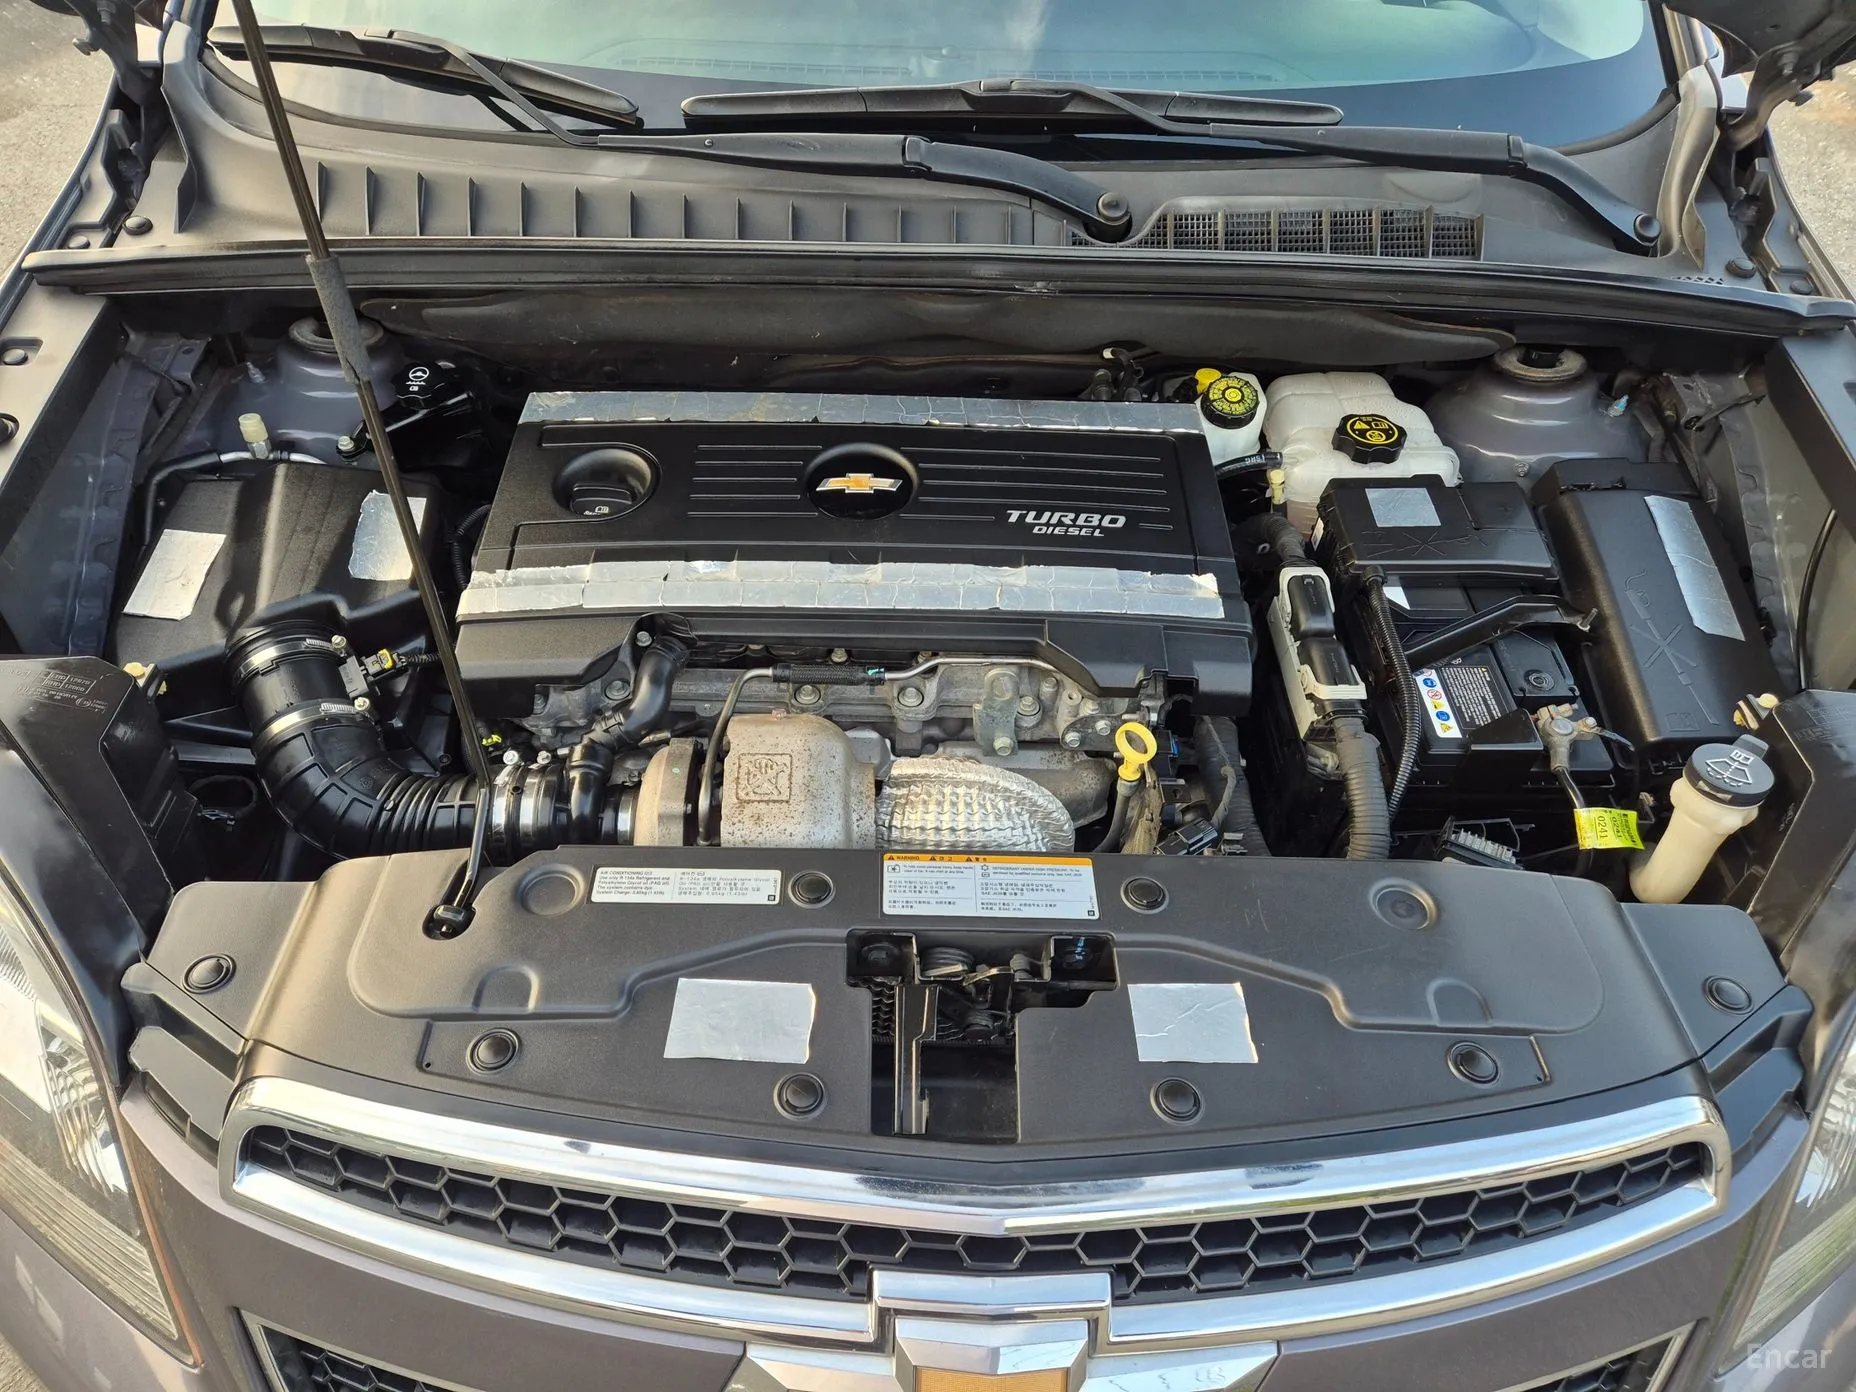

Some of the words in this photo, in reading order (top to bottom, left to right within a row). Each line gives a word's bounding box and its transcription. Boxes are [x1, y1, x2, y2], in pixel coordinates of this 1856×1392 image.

[1006, 510, 1127, 528] TURBO
[1032, 526, 1105, 536] DIESEL
[1598, 816, 1608, 840] 0241
